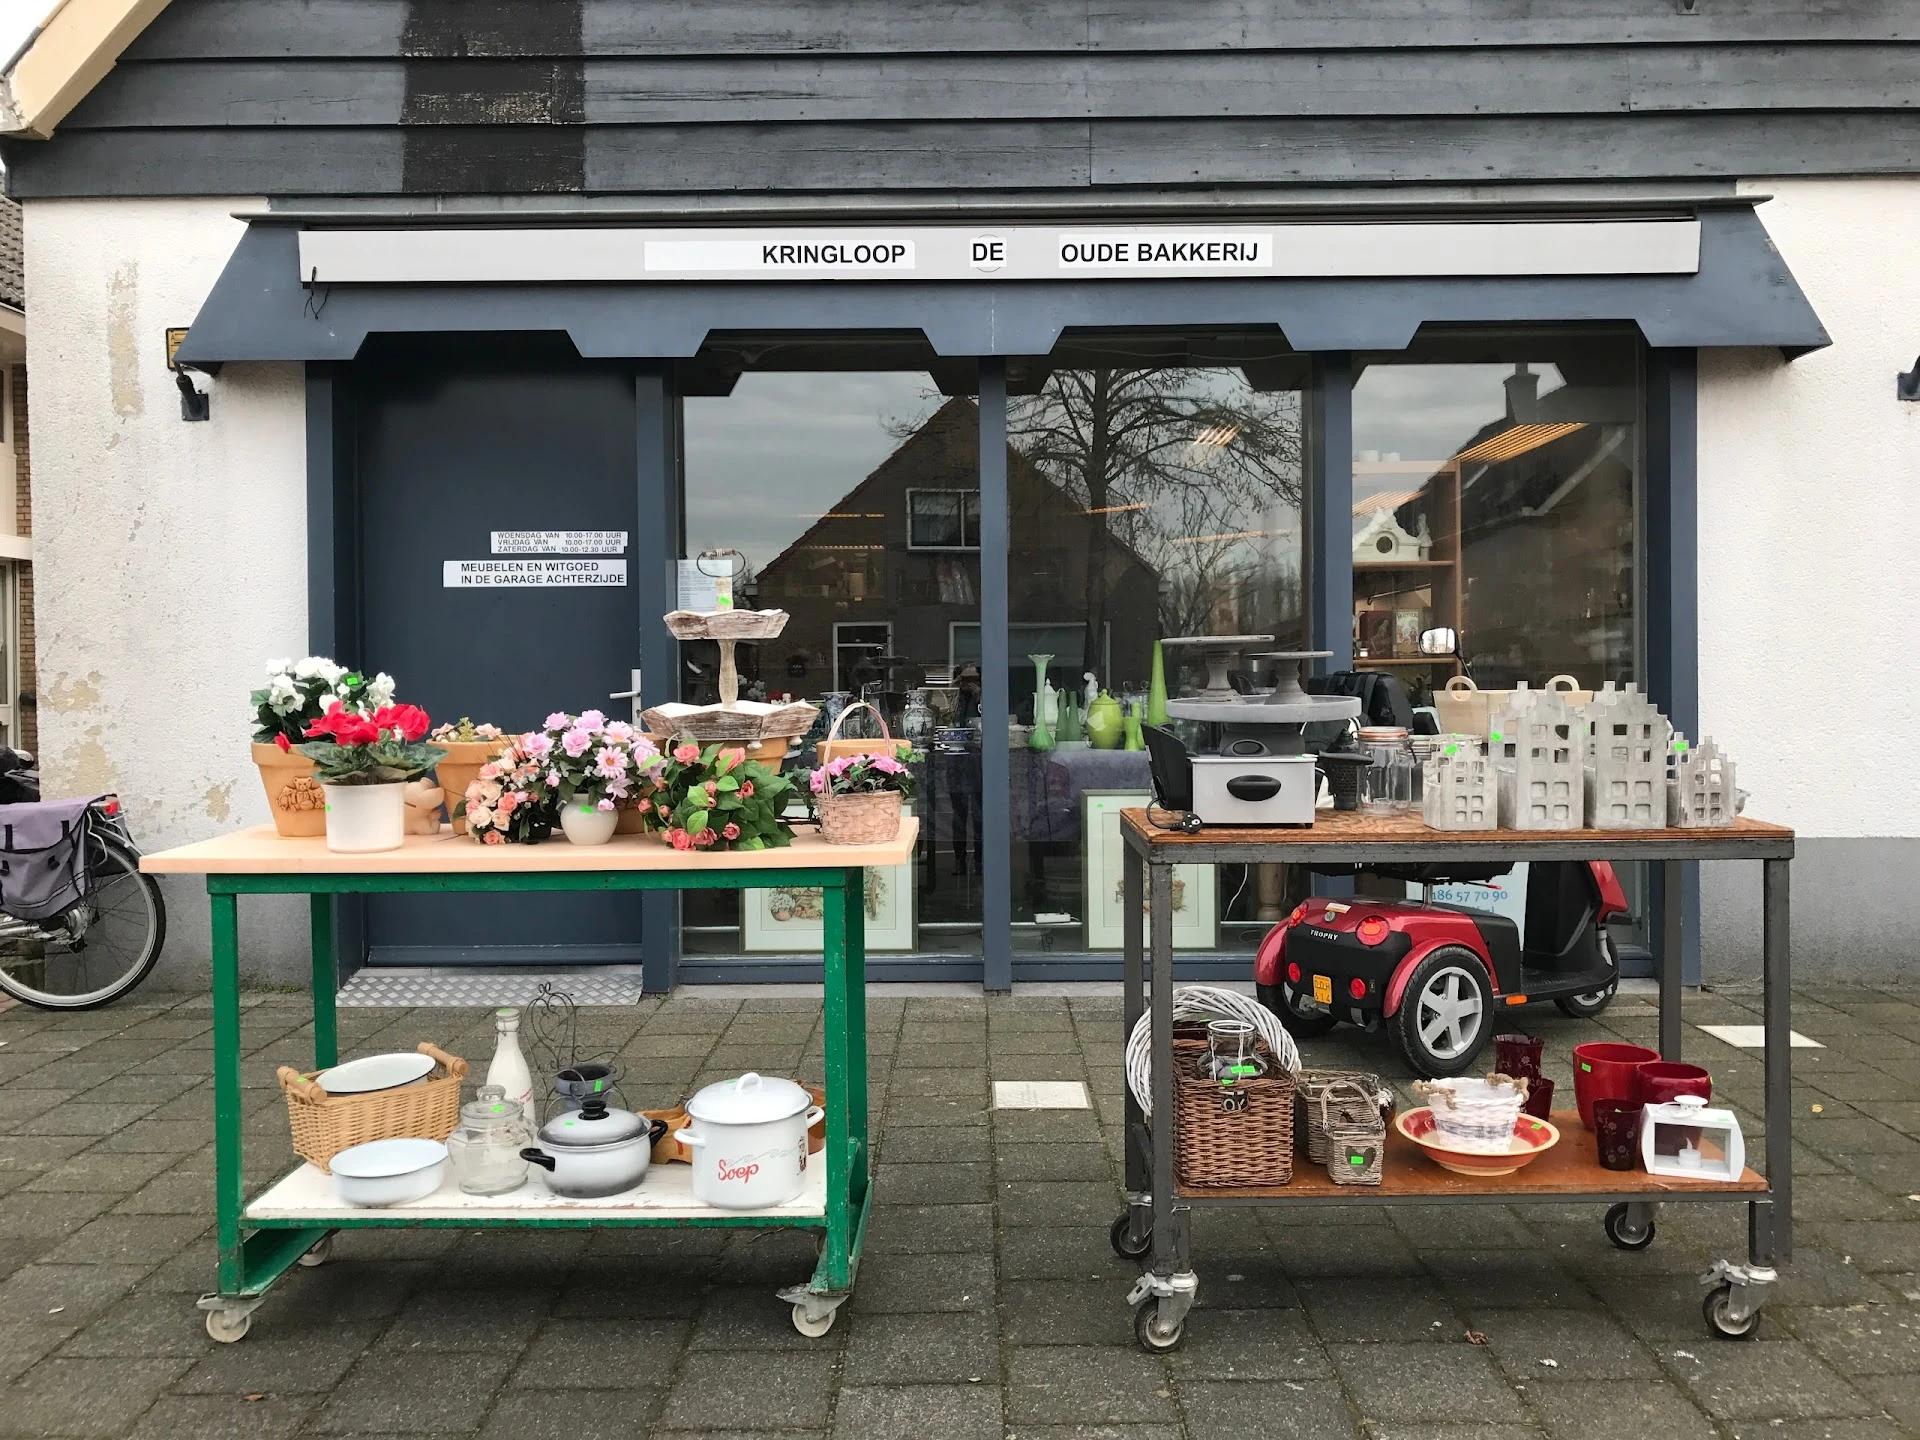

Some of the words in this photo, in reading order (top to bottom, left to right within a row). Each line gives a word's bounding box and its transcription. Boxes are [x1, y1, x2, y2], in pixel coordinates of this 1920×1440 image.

[762, 244, 906, 264] KRINGLOOP
[972, 242, 1004, 262] DE
[1061, 243, 1129, 263] OUDE
[1138, 242, 1258, 262] BAKKERIJ
[497, 545, 539, 553] ZATERDAG
[461, 562, 523, 572] MEUBELEN
[527, 562, 542, 571] EN
[545, 562, 599, 571] WITGOED
[461, 575, 472, 584] IN
[475, 575, 491, 584] DE
[494, 574, 543, 584] GARAGE
[546, 574, 625, 584] ACHTERZIJDE
[1456, 891, 1471, 903] 57
[1474, 891, 1489, 902] 70
[1492, 890, 1508, 902] 90
[1310, 929, 1339, 941] TROPHY
[717, 1158, 760, 1184] Soep
